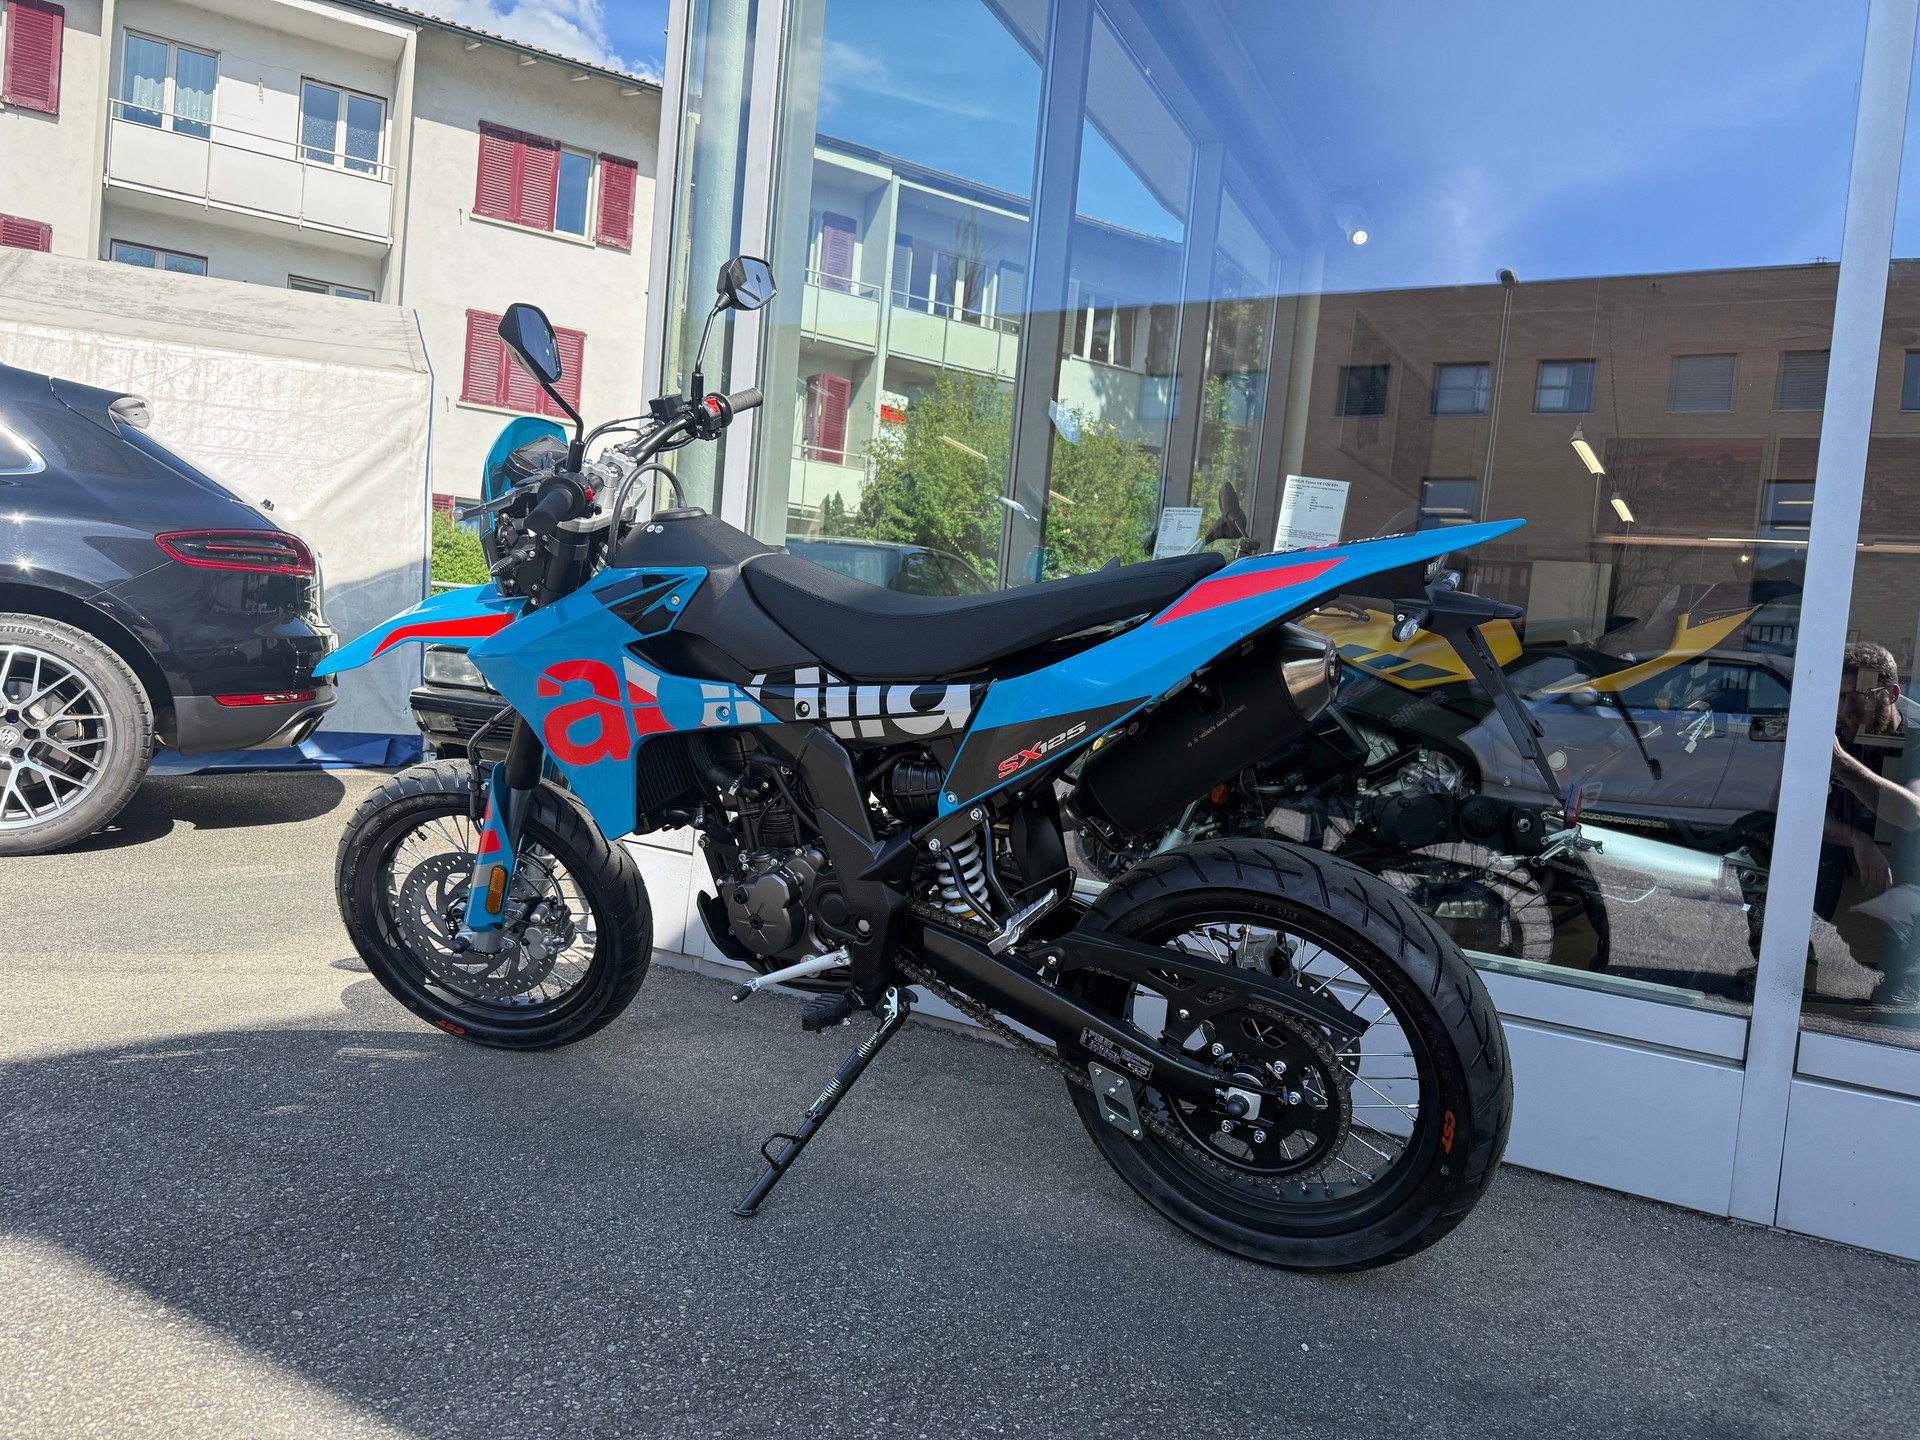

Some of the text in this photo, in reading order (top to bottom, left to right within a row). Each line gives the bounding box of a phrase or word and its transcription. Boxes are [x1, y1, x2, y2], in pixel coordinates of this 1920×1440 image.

[44, 632, 76, 653] Sport
[76, 645, 86, 656] 3
[435, 1019, 466, 1035] CST
[1441, 1110, 1456, 1154] CST
